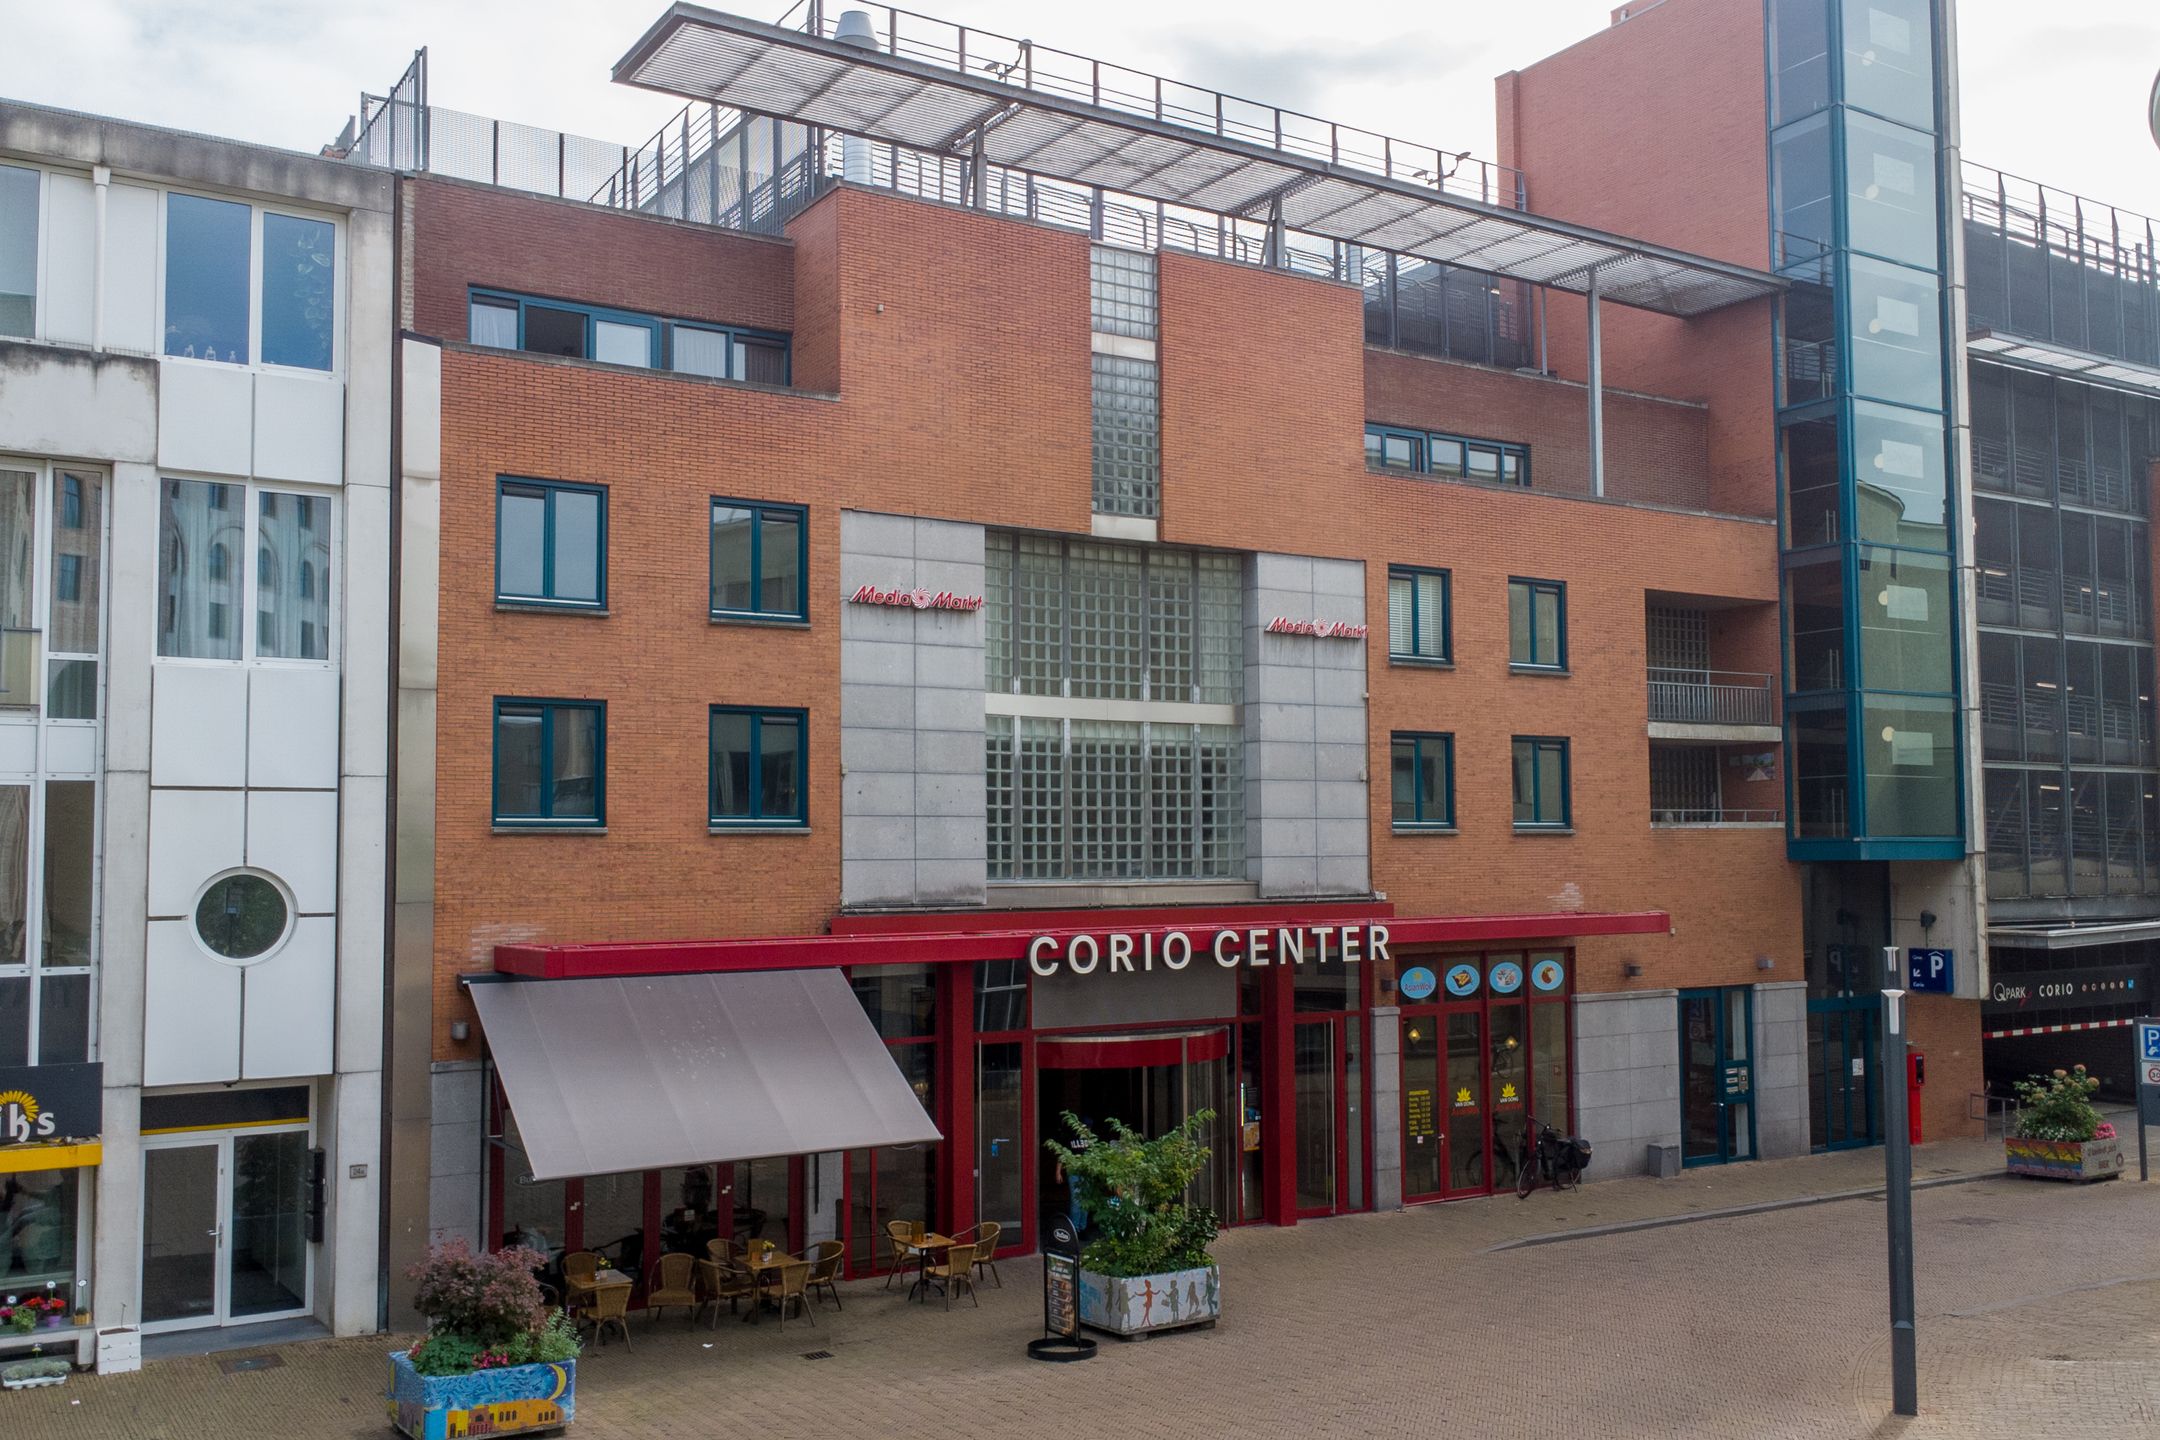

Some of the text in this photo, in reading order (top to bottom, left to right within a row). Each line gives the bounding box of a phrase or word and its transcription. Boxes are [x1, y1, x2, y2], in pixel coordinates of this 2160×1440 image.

[850, 585, 983, 610] Media Markt
[1265, 616, 1369, 639] Media Markt
[1028, 925, 1391, 976] CORIO CENTER
[1931, 955, 1944, 978] P
[2039, 983, 2073, 997] CORIO
